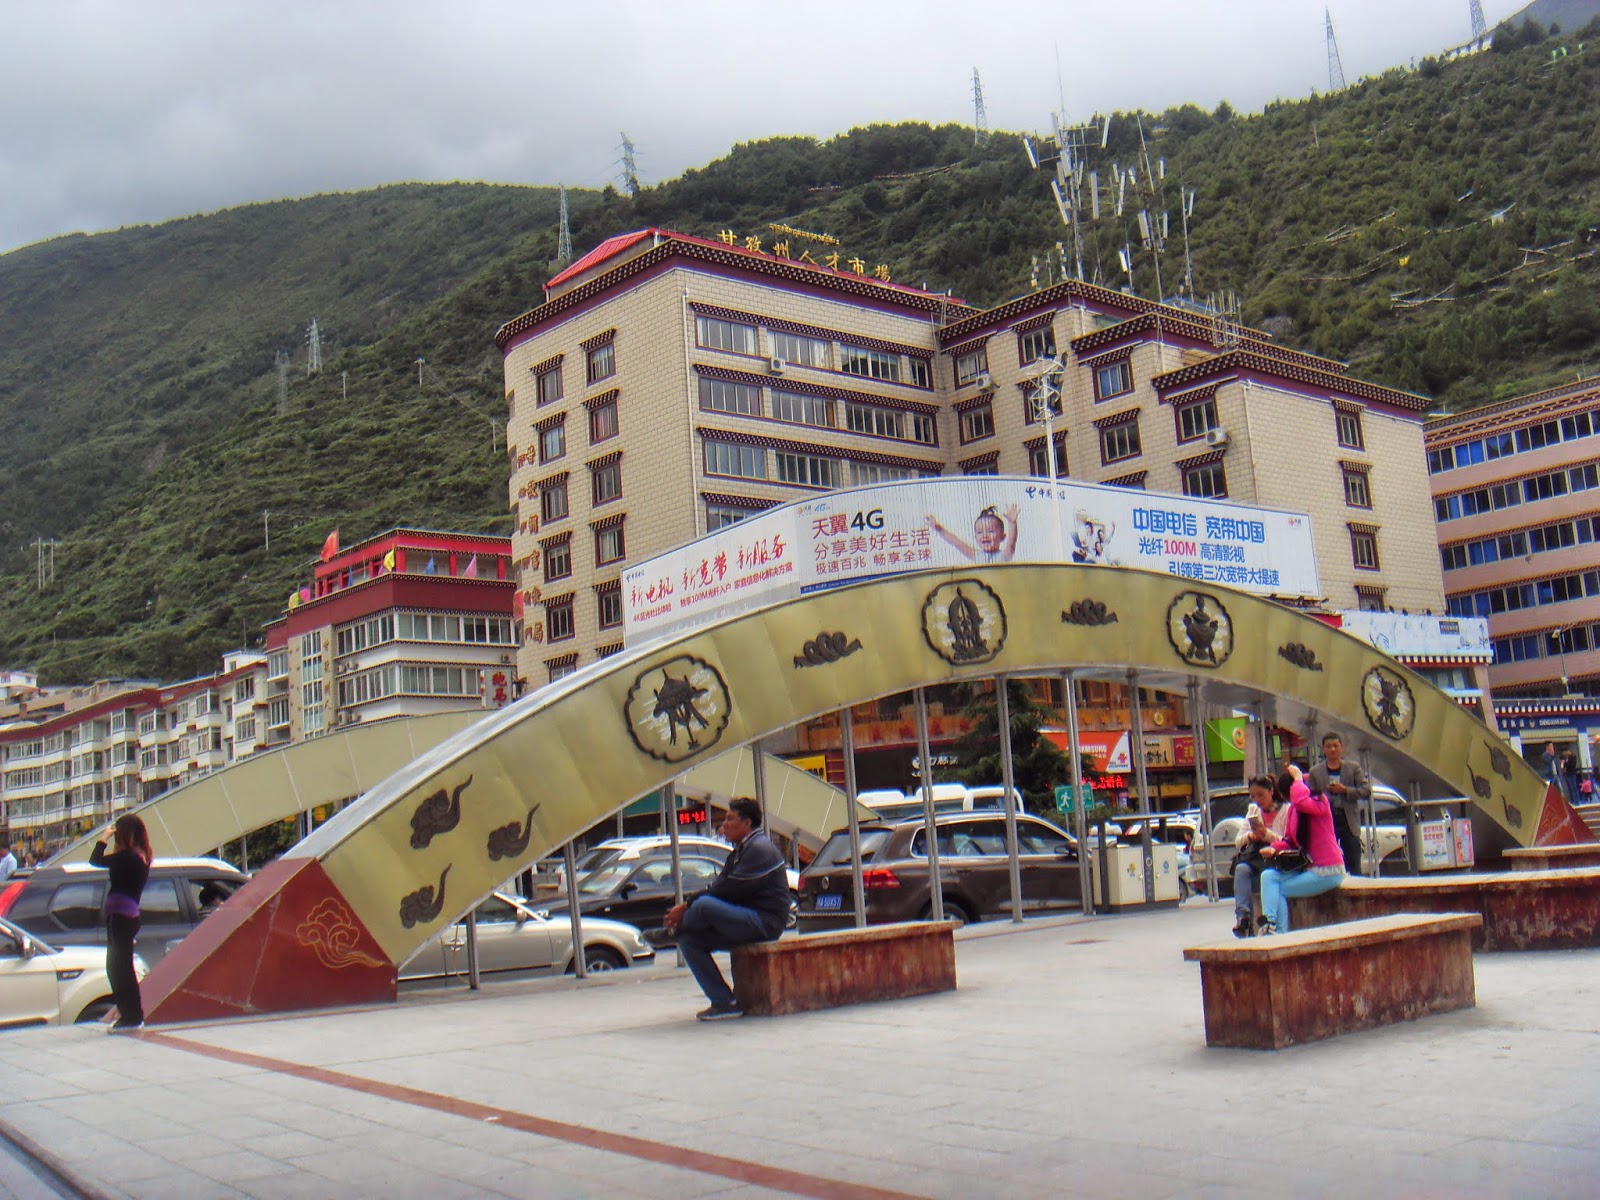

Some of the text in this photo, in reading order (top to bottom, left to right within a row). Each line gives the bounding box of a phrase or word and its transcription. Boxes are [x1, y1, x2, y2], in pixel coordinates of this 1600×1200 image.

[1132, 508, 1266, 544] 中国电信 宽带中国
[814, 527, 931, 561] 分享美好生活
[1200, 543, 1246, 563] 高清影视
[680, 551, 728, 592] 新宽带
[736, 534, 787, 569] 新服务
[816, 548, 932, 576] 极速百兆 畅享全球
[1168, 561, 1280, 587] 引领第三次宽带大提速
